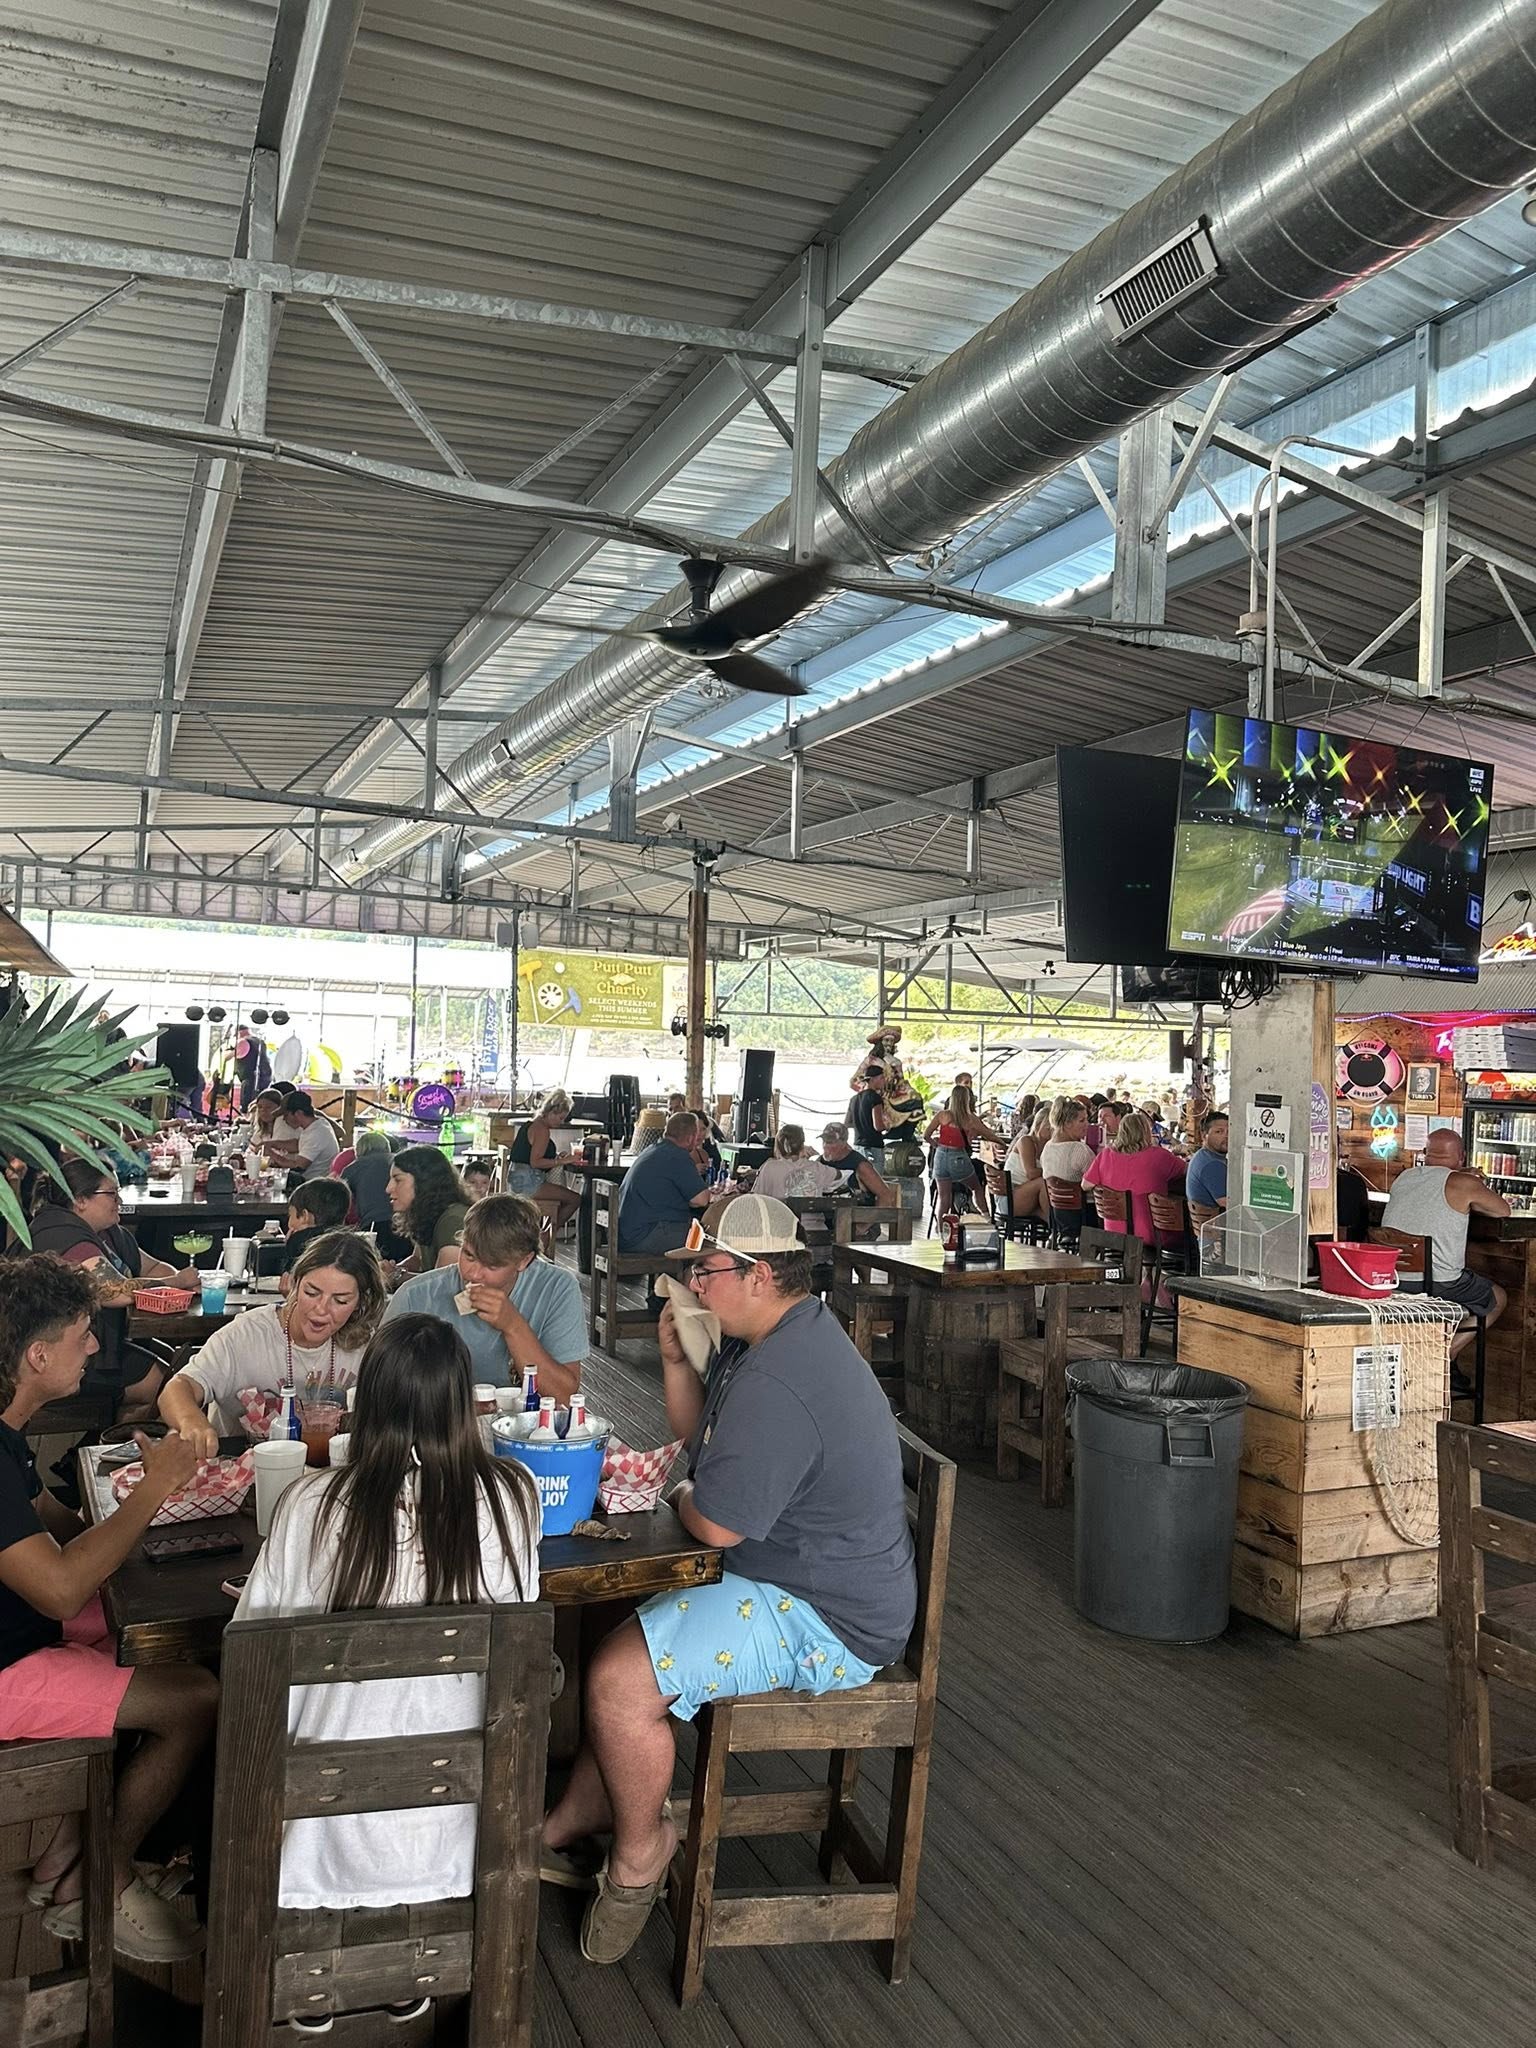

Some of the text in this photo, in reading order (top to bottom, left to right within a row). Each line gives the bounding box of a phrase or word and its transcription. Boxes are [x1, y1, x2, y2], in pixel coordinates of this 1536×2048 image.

[1401, 866, 1425, 893] LIGHT
[1470, 900, 1481, 924] B
[1182, 932, 1206, 942] ESPN
[1294, 943, 1307, 951] Jays
[593, 960, 652, 976] Putt Putt
[1406, 962, 1424, 970] TONIGHT
[1426, 957, 1440, 965] PARK
[597, 981, 648, 999] Charity
[588, 997, 657, 1009] SELECT WEEKENDS
[599, 1005, 648, 1015] THIS SUMMER
[483, 1001, 496, 1062] STATE DOCK
[1510, 1084, 1525, 1092] ICE
[1249, 1126, 1286, 1144] No Smoking
[1263, 1139, 1270, 1149] in
[539, 1475, 571, 1491] RINK
[541, 1490, 569, 1507] JOY
